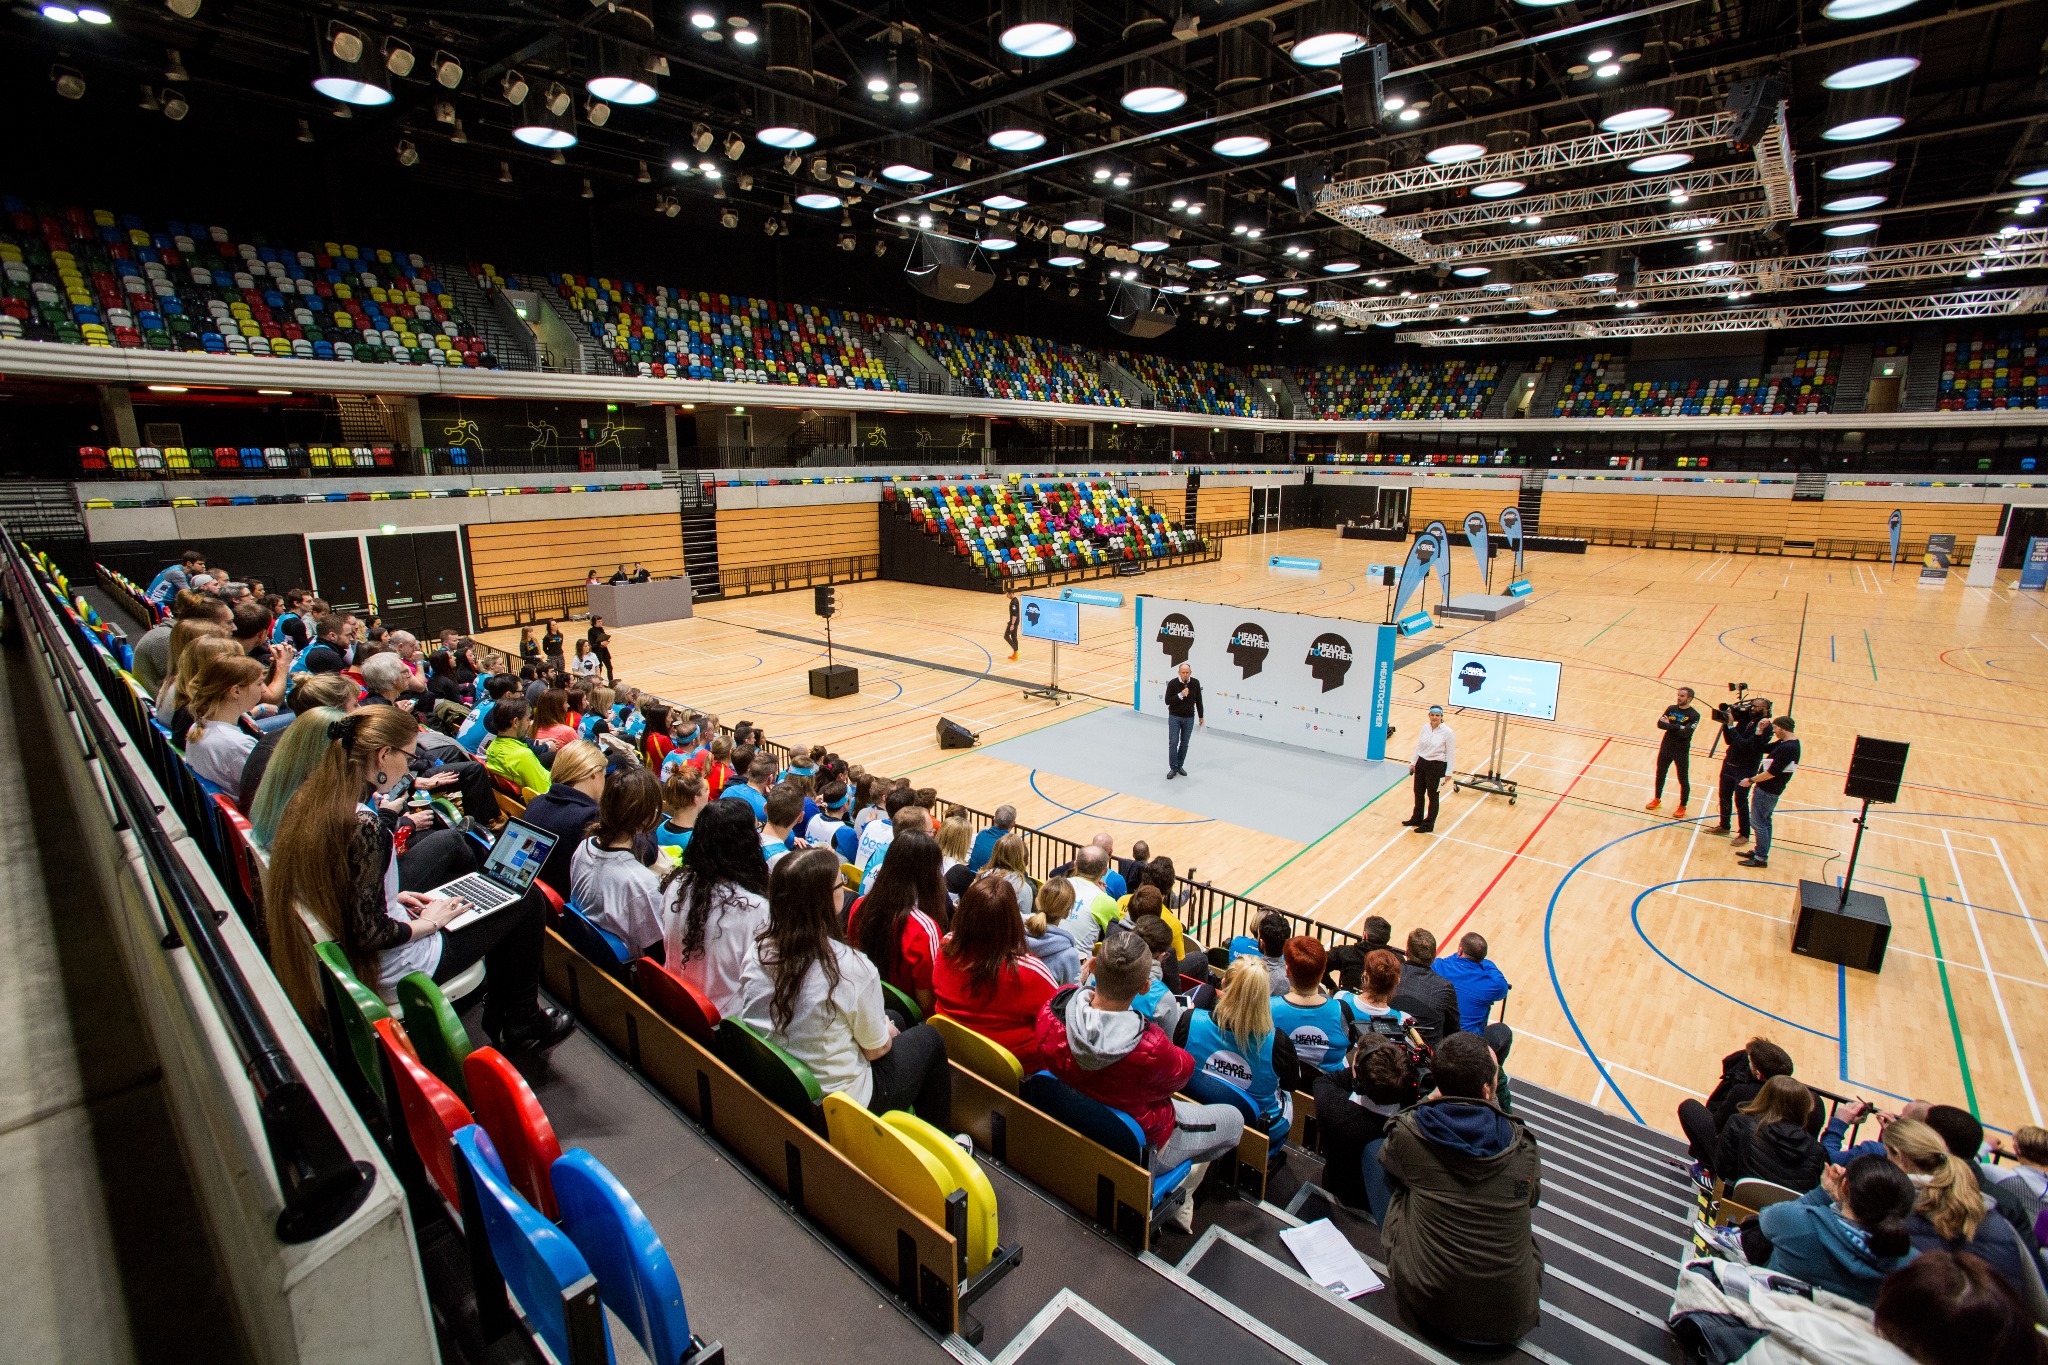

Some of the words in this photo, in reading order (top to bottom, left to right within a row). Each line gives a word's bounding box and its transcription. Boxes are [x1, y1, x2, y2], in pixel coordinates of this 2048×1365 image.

[1160, 626, 1195, 639] TOGETHER
[1166, 621, 1189, 632] HEADS
[1231, 636, 1270, 649] TOGETHER
[1238, 631, 1264, 641] HEADS
[1309, 647, 1353, 661] TOGETHER
[1317, 642, 1346, 653] HEADS
[1375, 661, 1388, 728] #HEADSTOGETHER
[1295, 1034, 1323, 1042] HEADS
[1205, 1062, 1253, 1081] TOGETHER
[1213, 1058, 1245, 1073] HEADS
